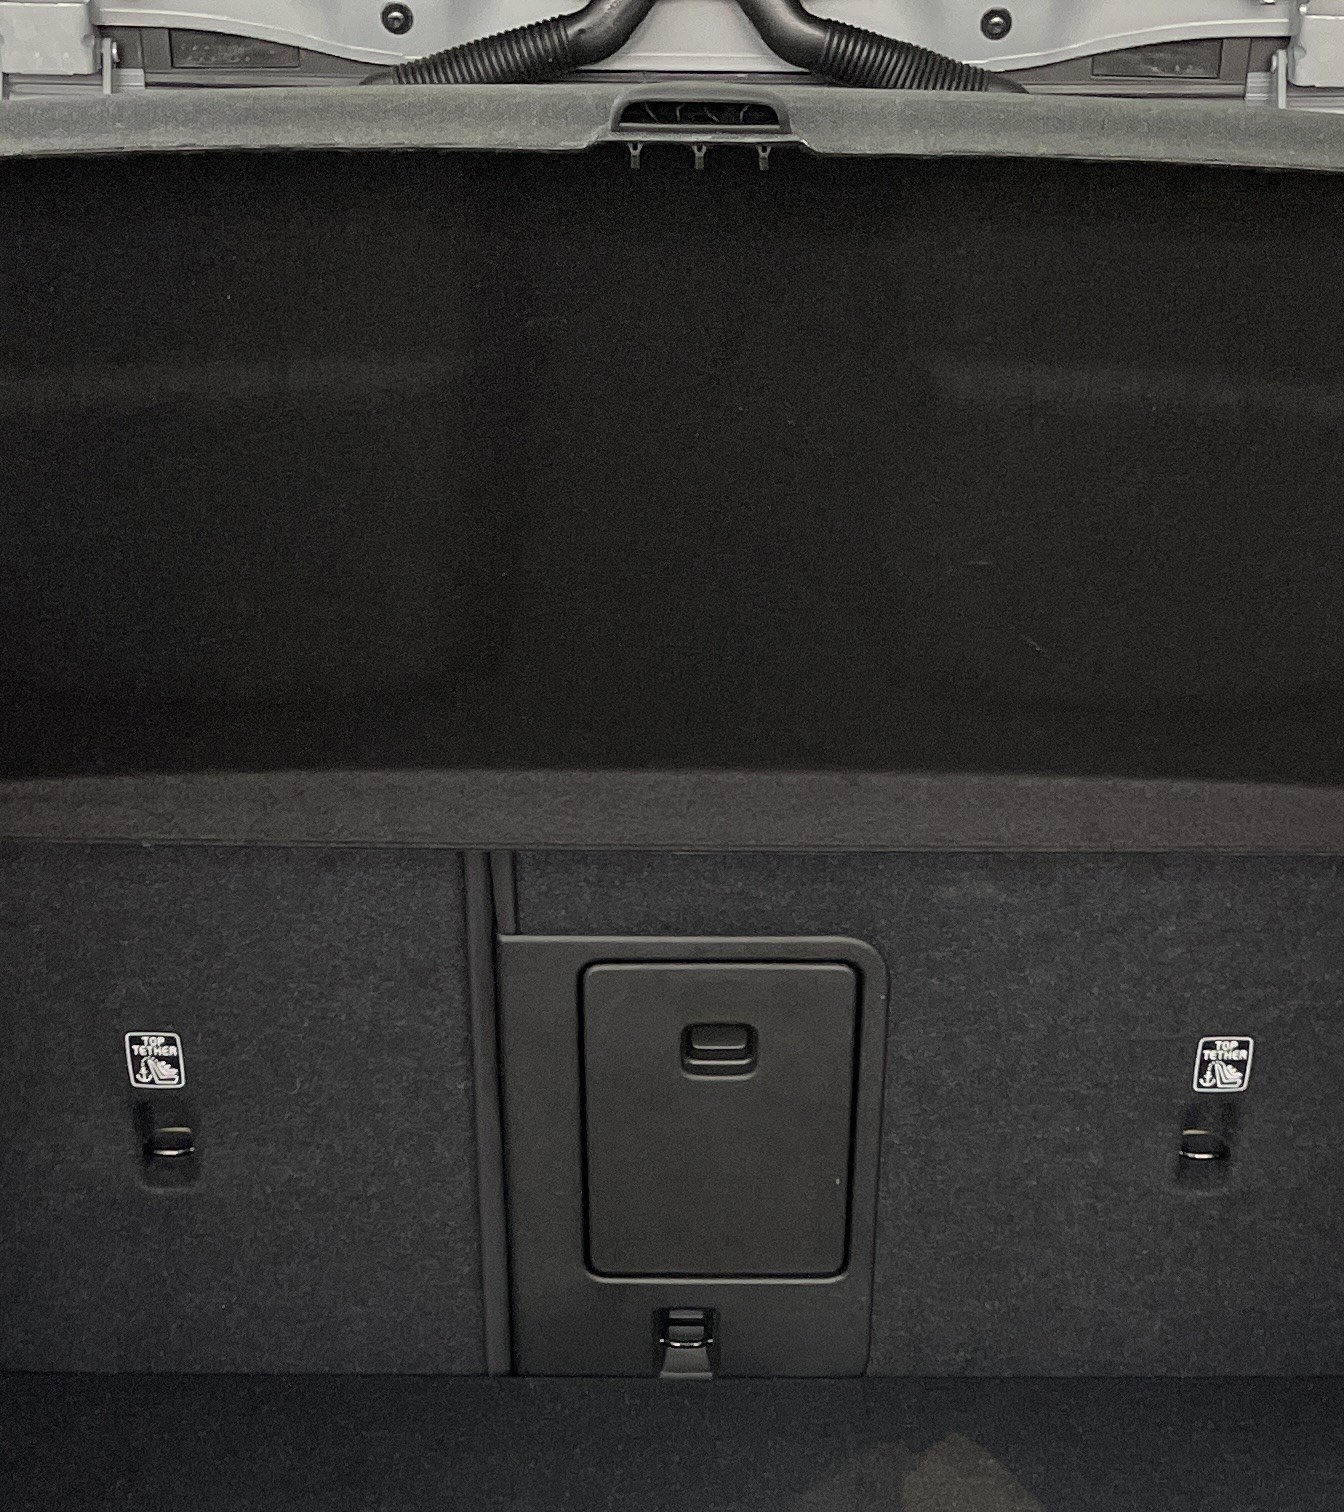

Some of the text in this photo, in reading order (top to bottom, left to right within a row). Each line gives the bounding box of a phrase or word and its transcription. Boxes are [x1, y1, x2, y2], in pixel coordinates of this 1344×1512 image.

[141, 1036, 165, 1046] TOP
[1214, 1040, 1238, 1051] TOP
[131, 1044, 177, 1056] TETHER
[1202, 1049, 1248, 1060] TETHER
